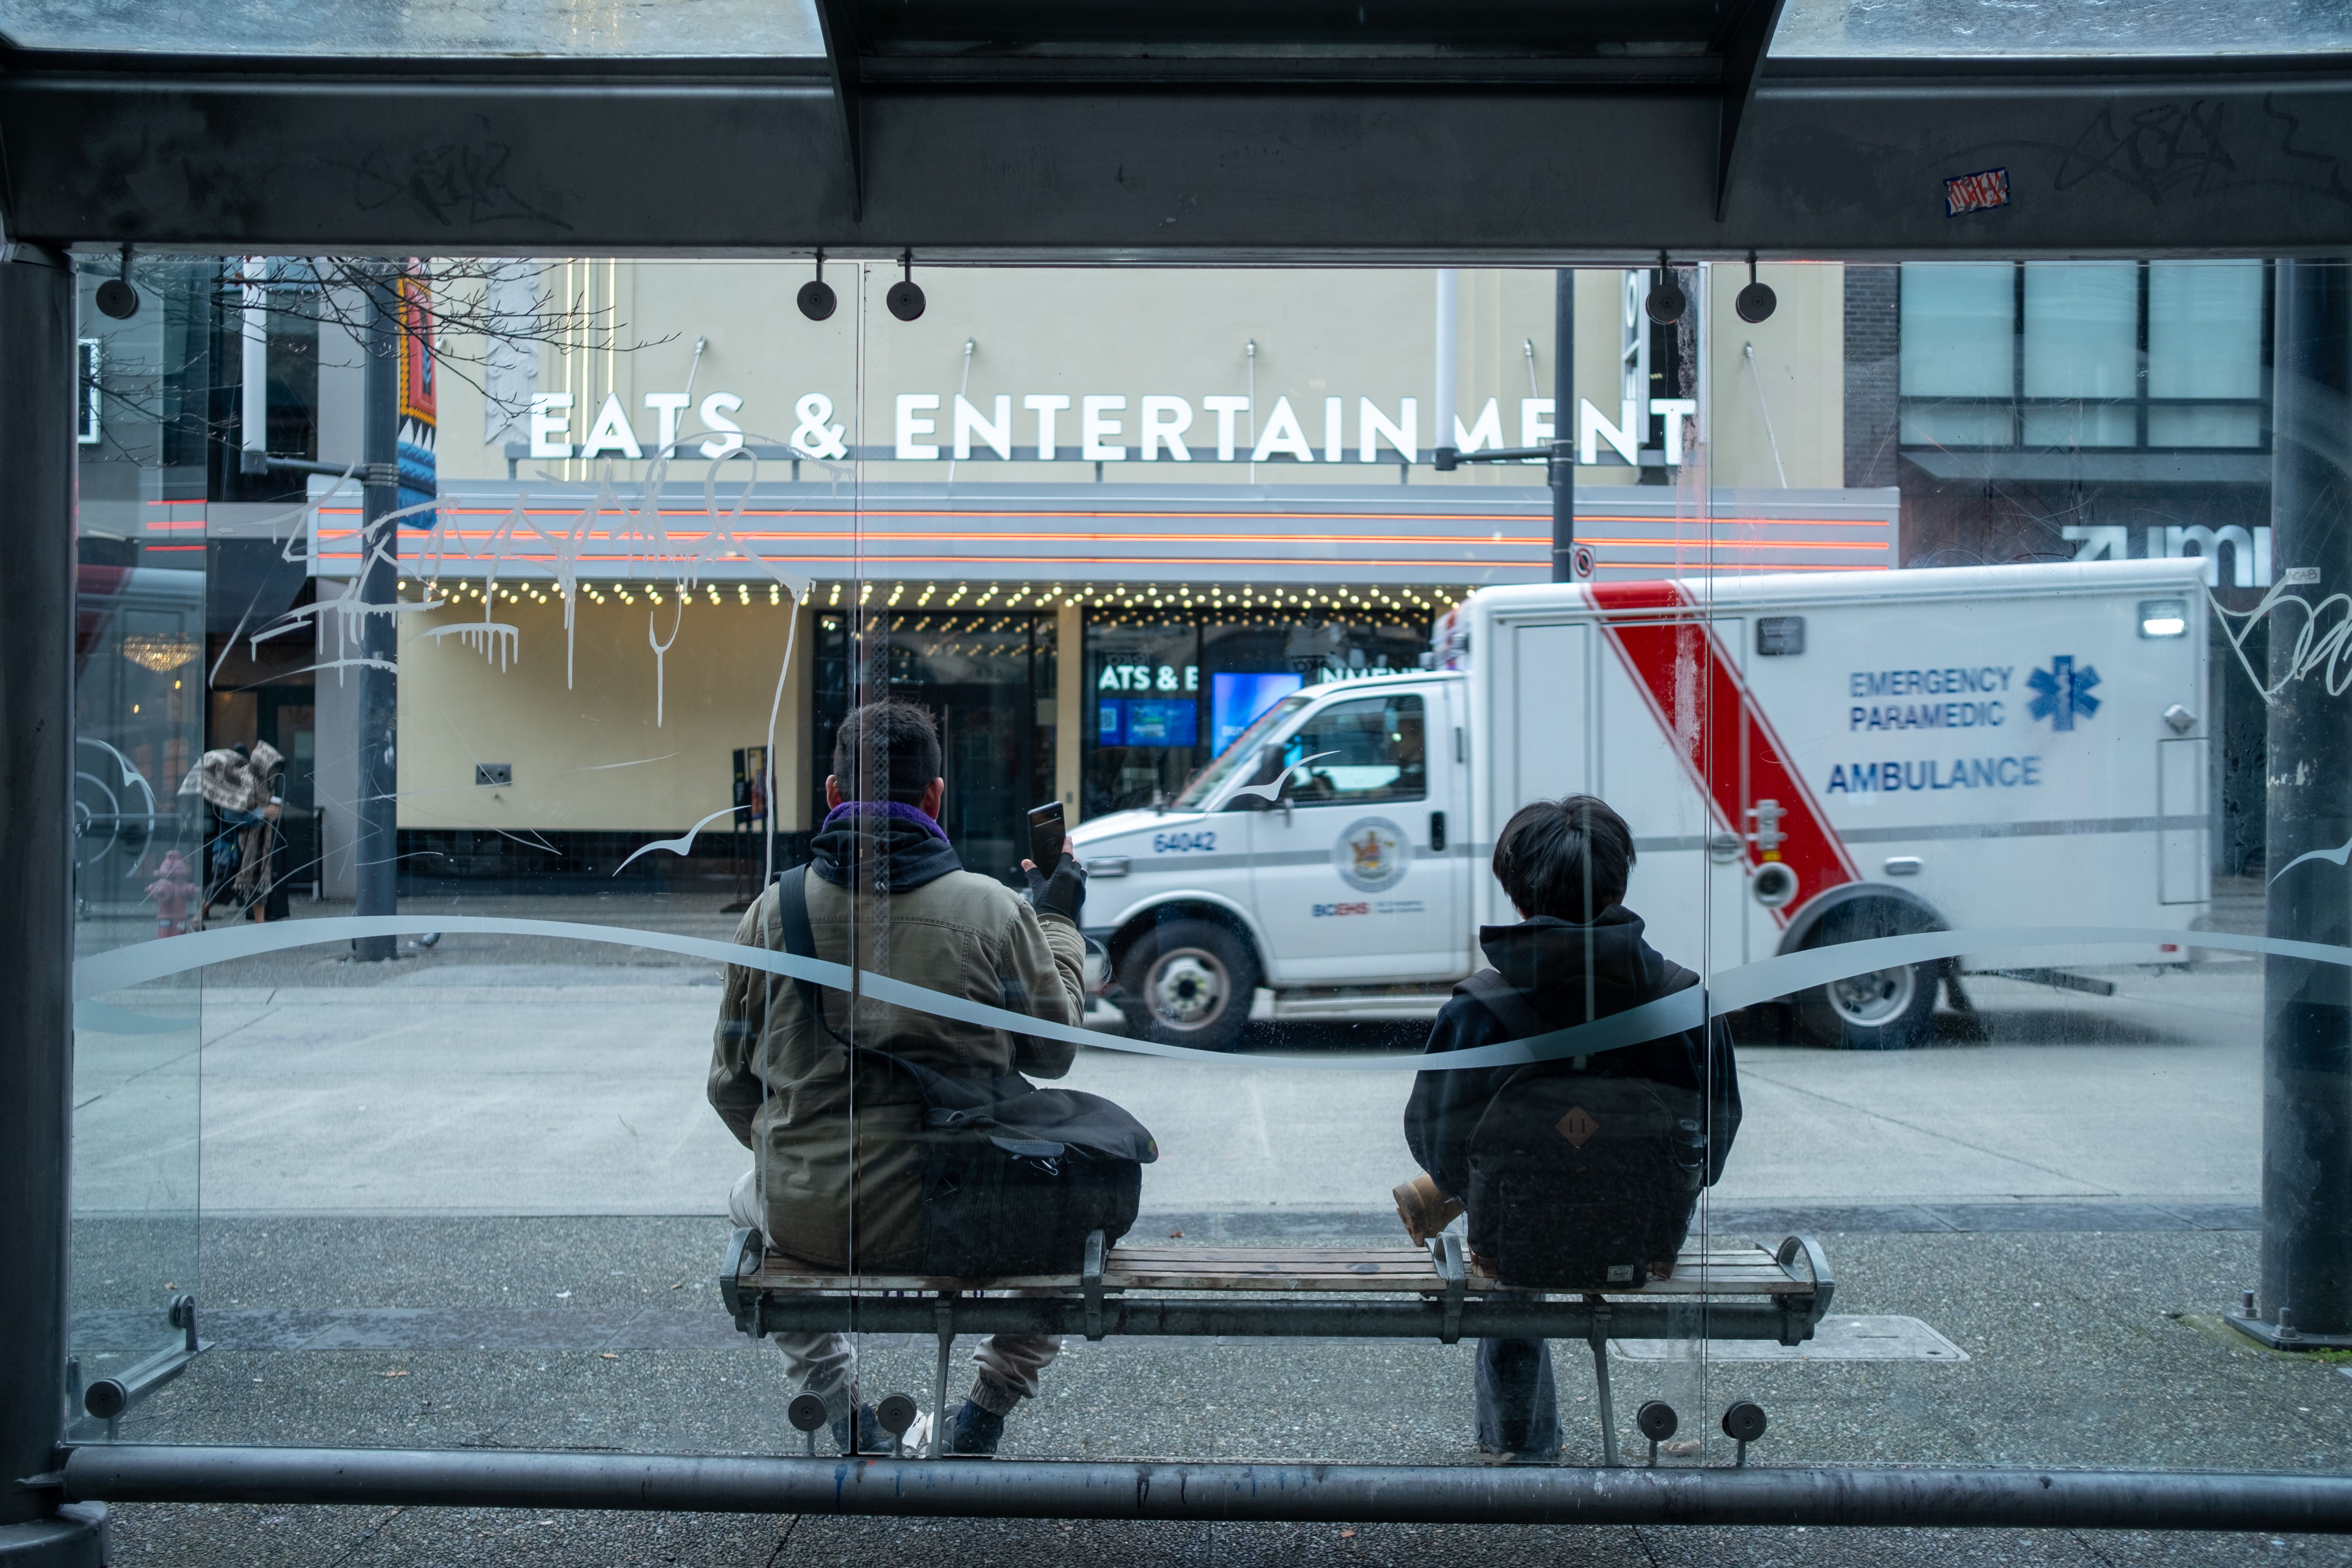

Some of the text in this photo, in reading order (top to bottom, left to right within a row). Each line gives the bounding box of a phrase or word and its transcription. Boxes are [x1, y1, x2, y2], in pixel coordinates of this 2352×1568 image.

[530, 391, 1697, 466] EATS & ENTERTAINMENT
[1099, 665, 1151, 691] ATS
[1156, 665, 1179, 691] &
[1849, 666, 2014, 697] EMERGENCY
[1849, 701, 2006, 731] PARAMEDIC
[1826, 756, 2043, 793] AMBULANCE
[1153, 831, 1217, 853] 64042
